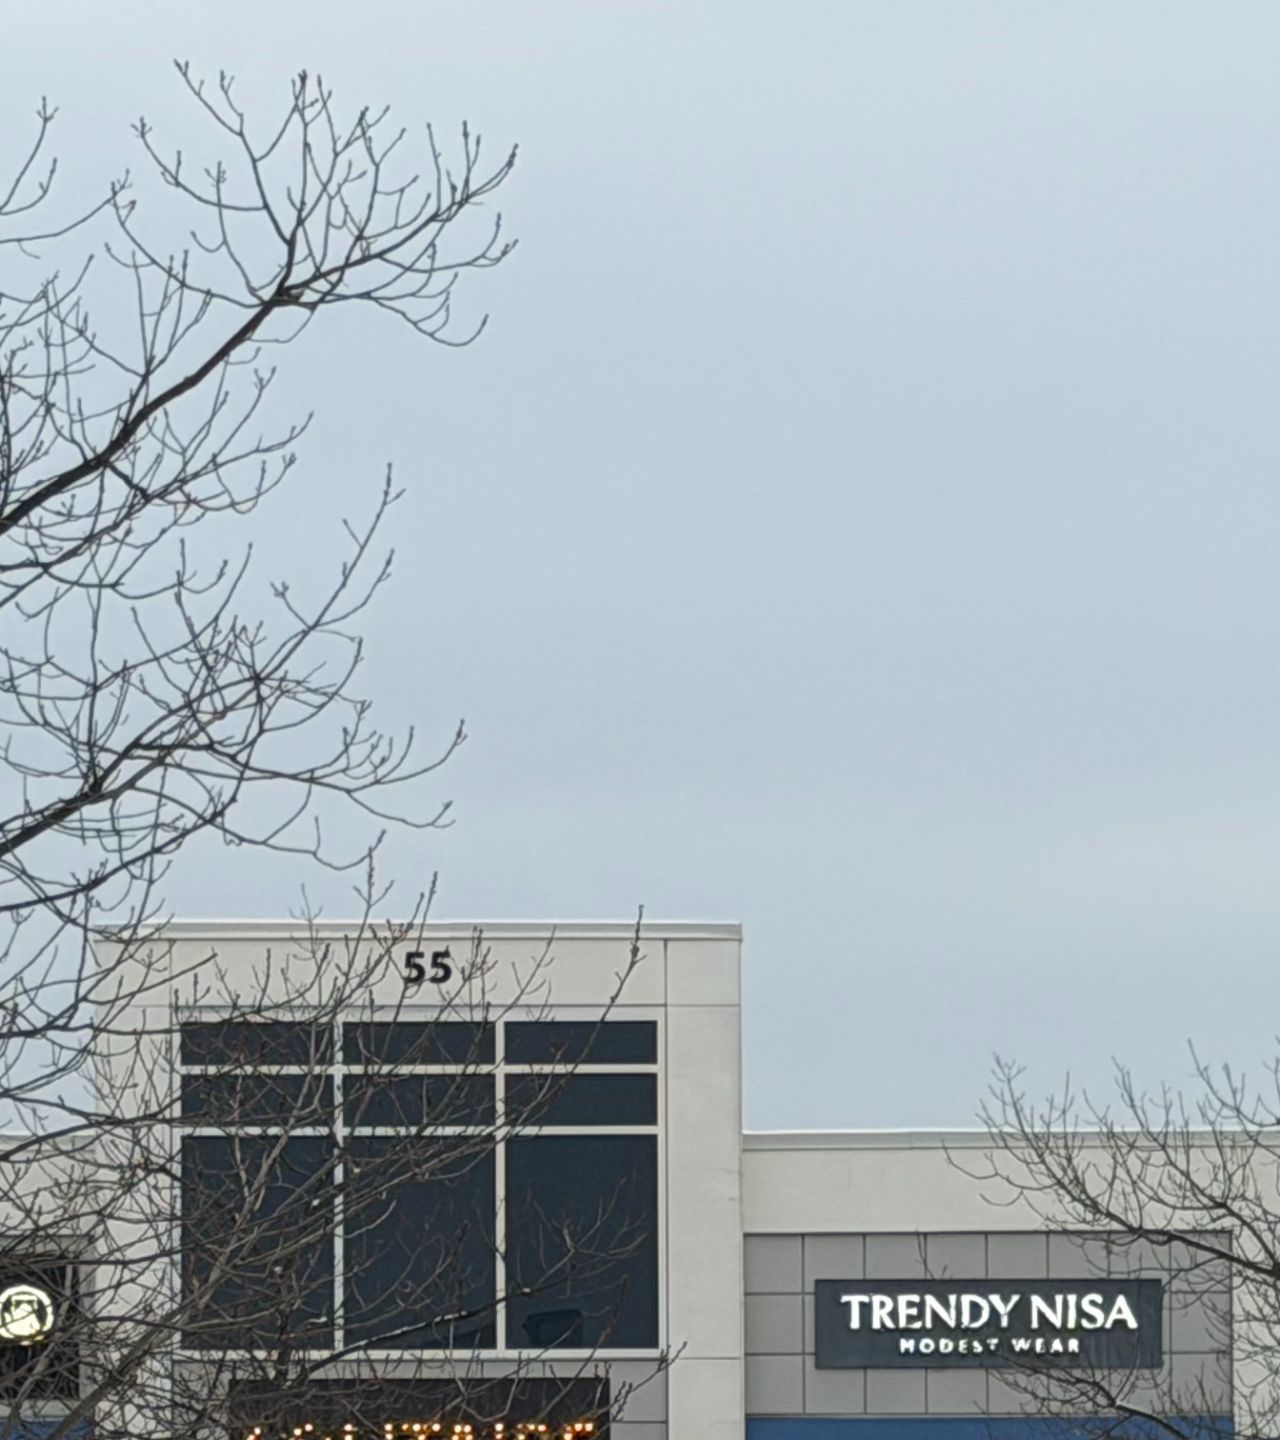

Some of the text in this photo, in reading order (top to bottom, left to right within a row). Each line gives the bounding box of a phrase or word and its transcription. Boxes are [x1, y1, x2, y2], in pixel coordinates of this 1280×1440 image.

[405, 951, 451, 984] 55
[840, 1293, 1138, 1330] TRENDY NISA
[900, 1338, 1080, 1354] MODEST WEAR
